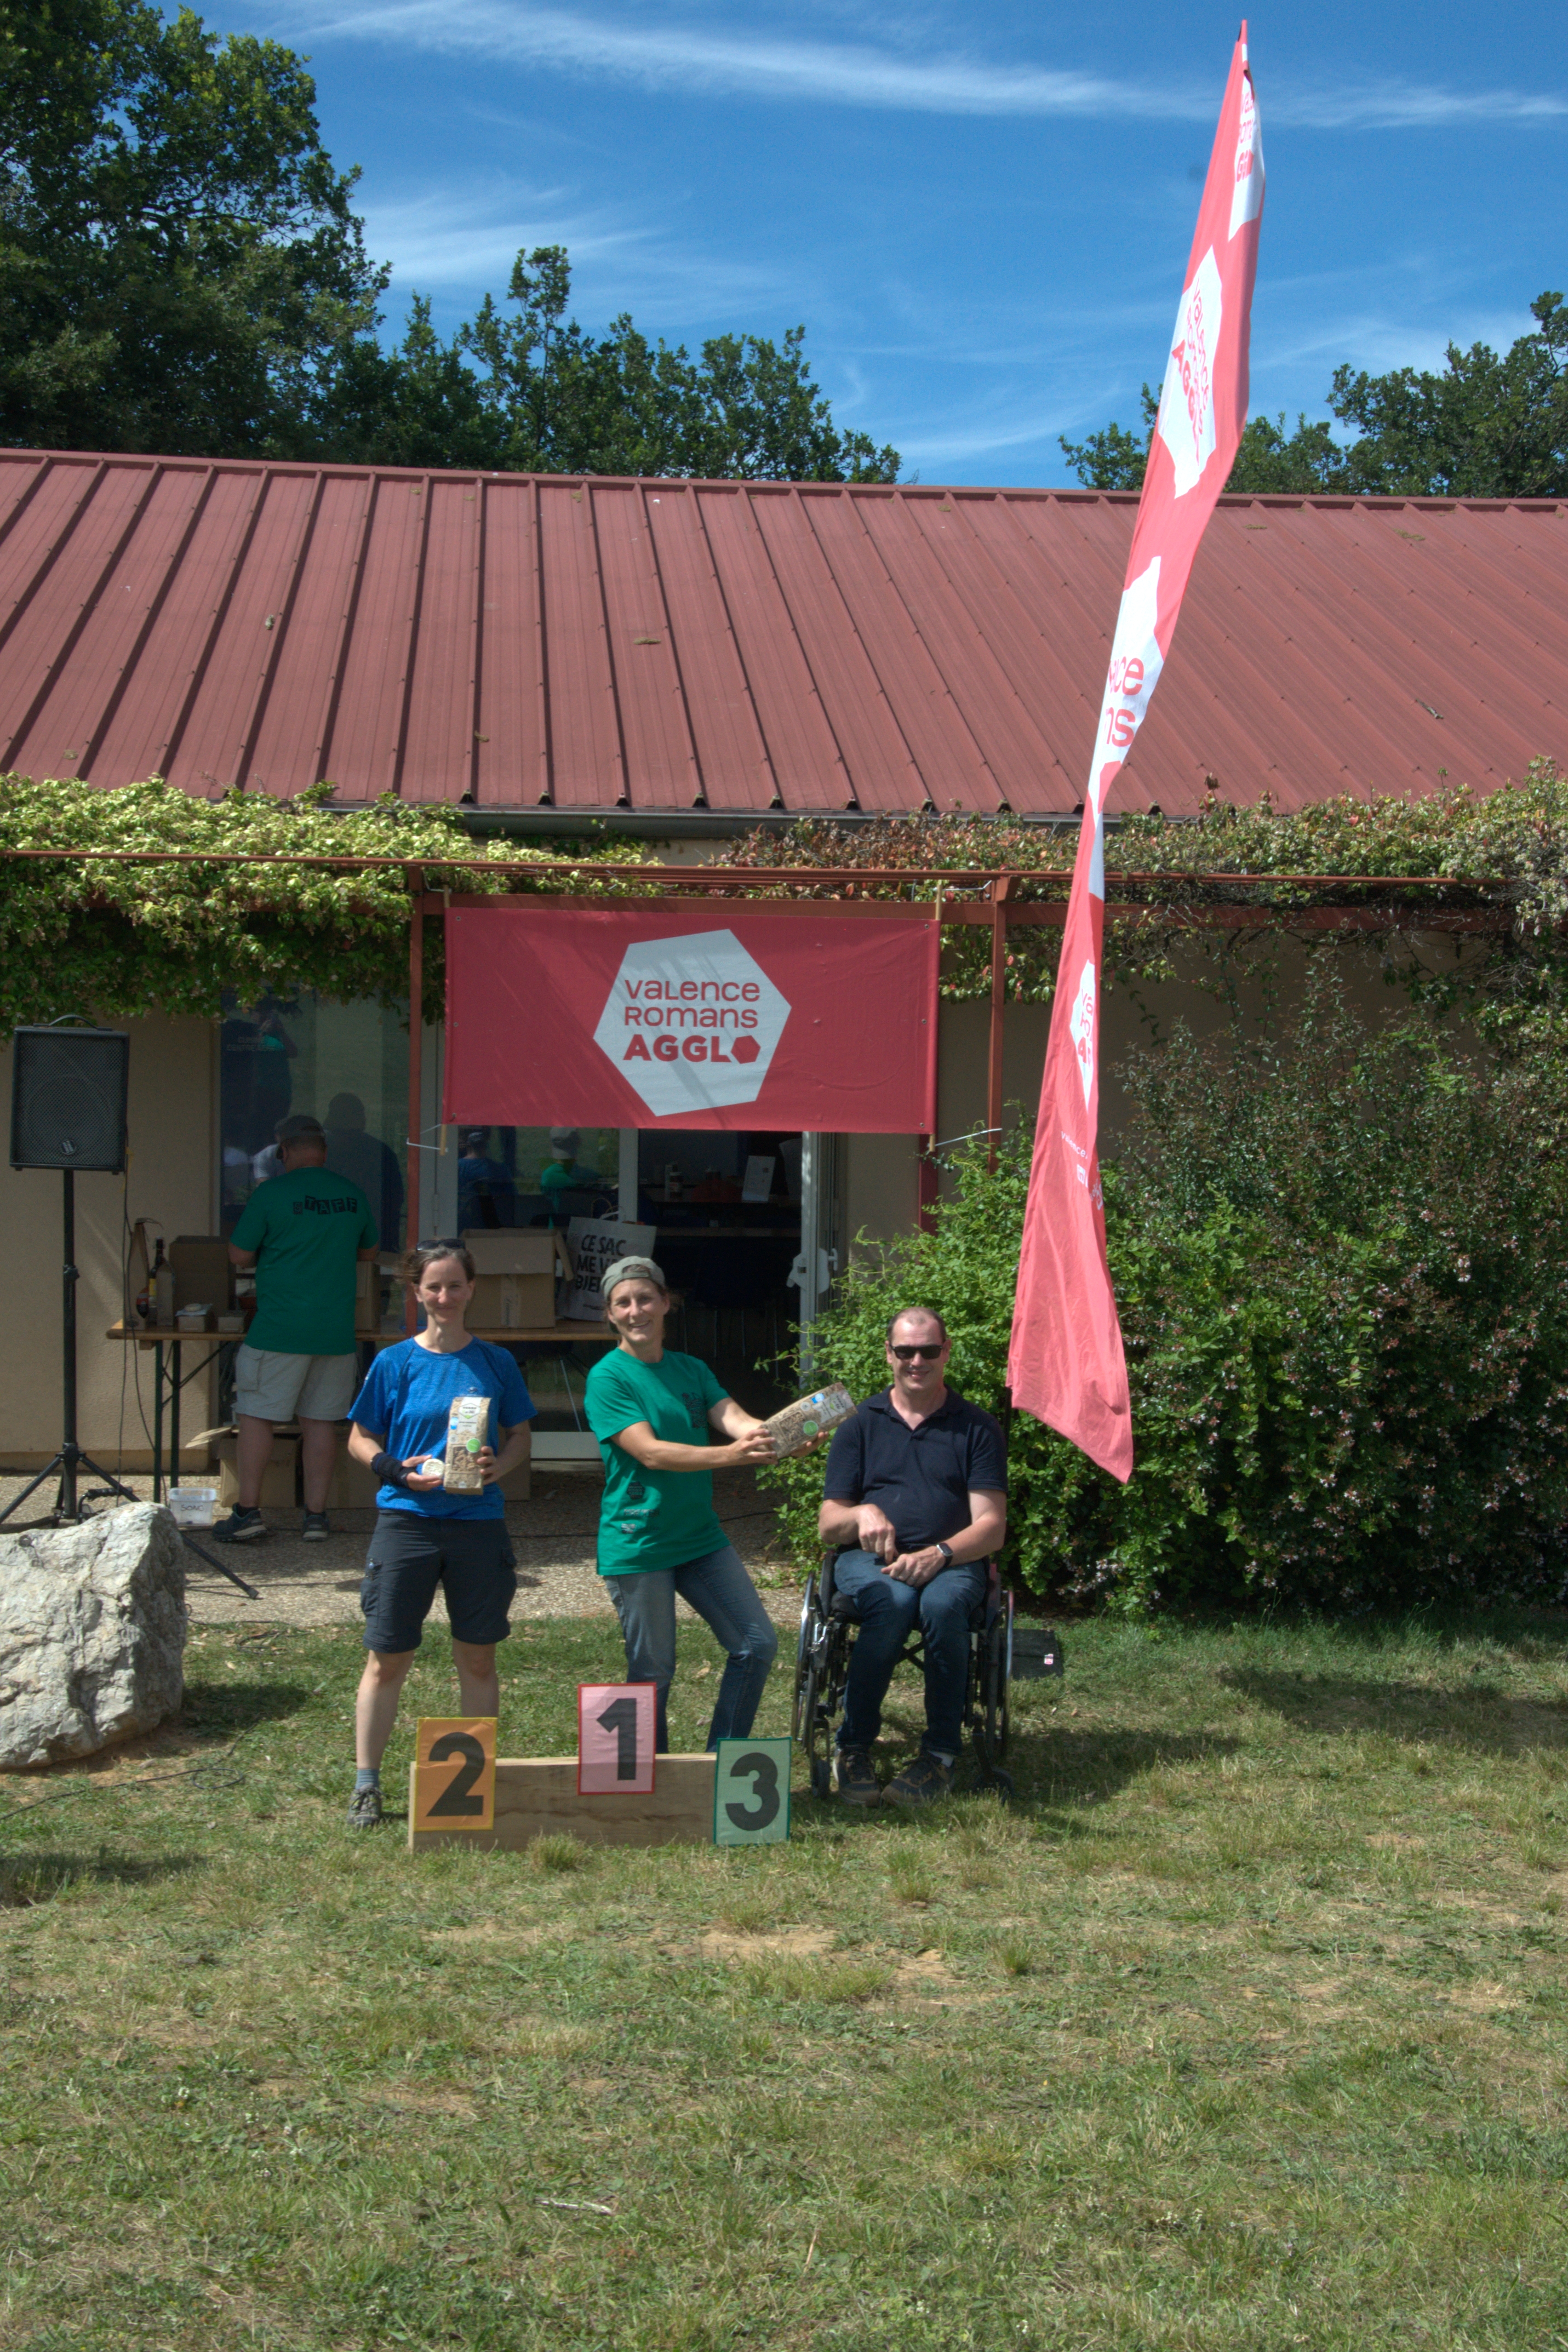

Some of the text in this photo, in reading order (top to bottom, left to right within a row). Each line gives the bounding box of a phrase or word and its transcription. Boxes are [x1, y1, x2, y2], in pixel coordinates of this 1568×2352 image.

[293, 1195, 357, 1215] STAFF
[577, 1254, 597, 1273] ME
[581, 1234, 626, 1256] CE SAC
[596, 1698, 637, 1781] 1
[427, 1732, 485, 1817] 2
[725, 1753, 781, 1831] 3
